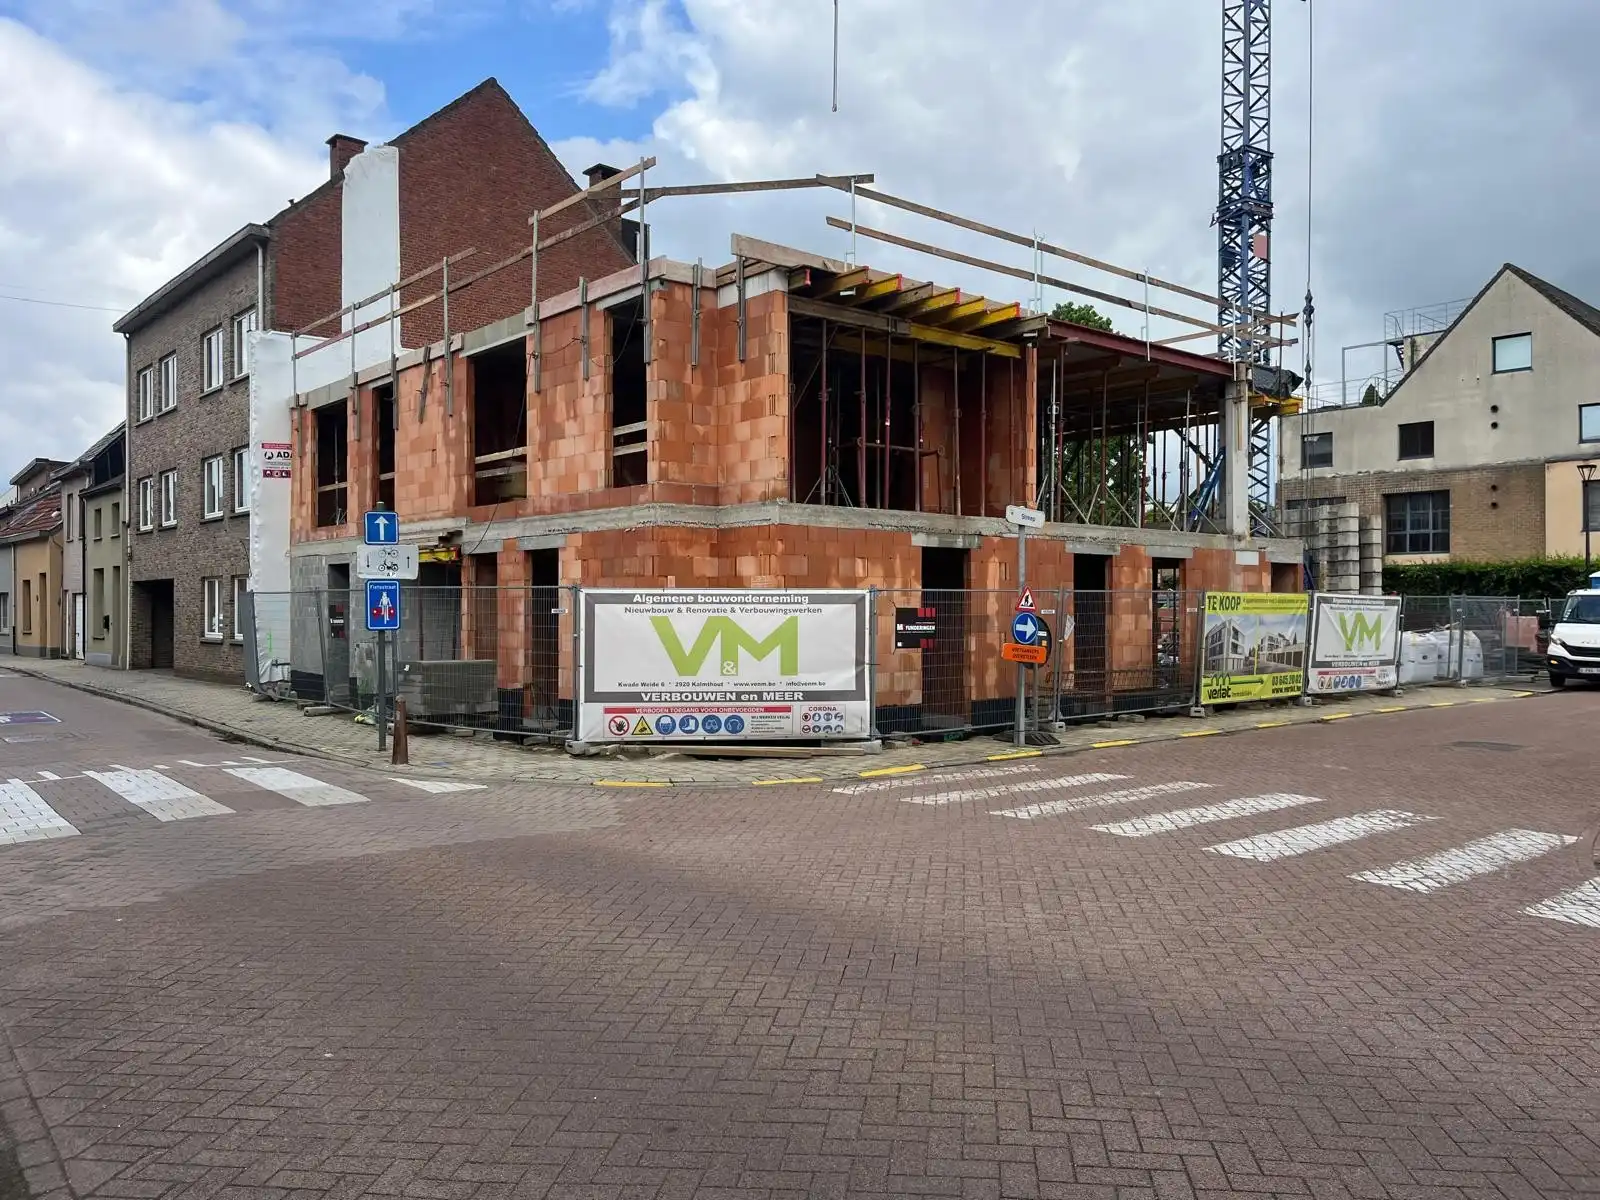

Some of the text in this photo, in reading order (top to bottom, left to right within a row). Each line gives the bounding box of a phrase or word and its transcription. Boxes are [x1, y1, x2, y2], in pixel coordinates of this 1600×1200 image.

[633, 594, 809, 604] Algemene bouwonderneming
[1207, 595, 1241, 611] TE KOOP
[739, 607, 822, 615] Verbouwingswerken
[641, 692, 804, 702] VERBOUWEN en MEER
